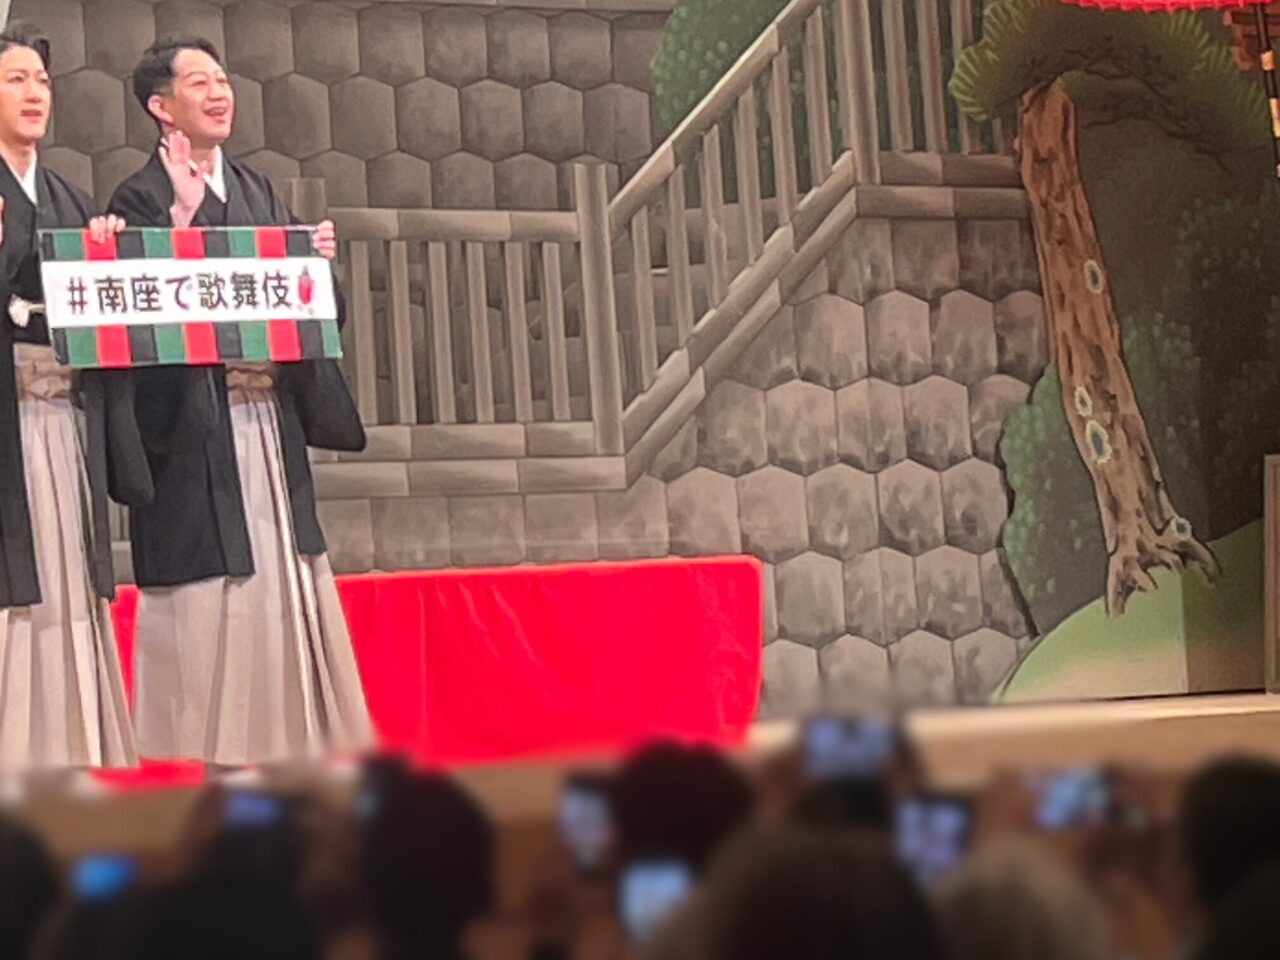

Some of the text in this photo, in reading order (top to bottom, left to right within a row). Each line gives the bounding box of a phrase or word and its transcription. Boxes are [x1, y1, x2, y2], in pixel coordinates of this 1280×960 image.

[67, 271, 293, 315] #南座で歌舞伎
